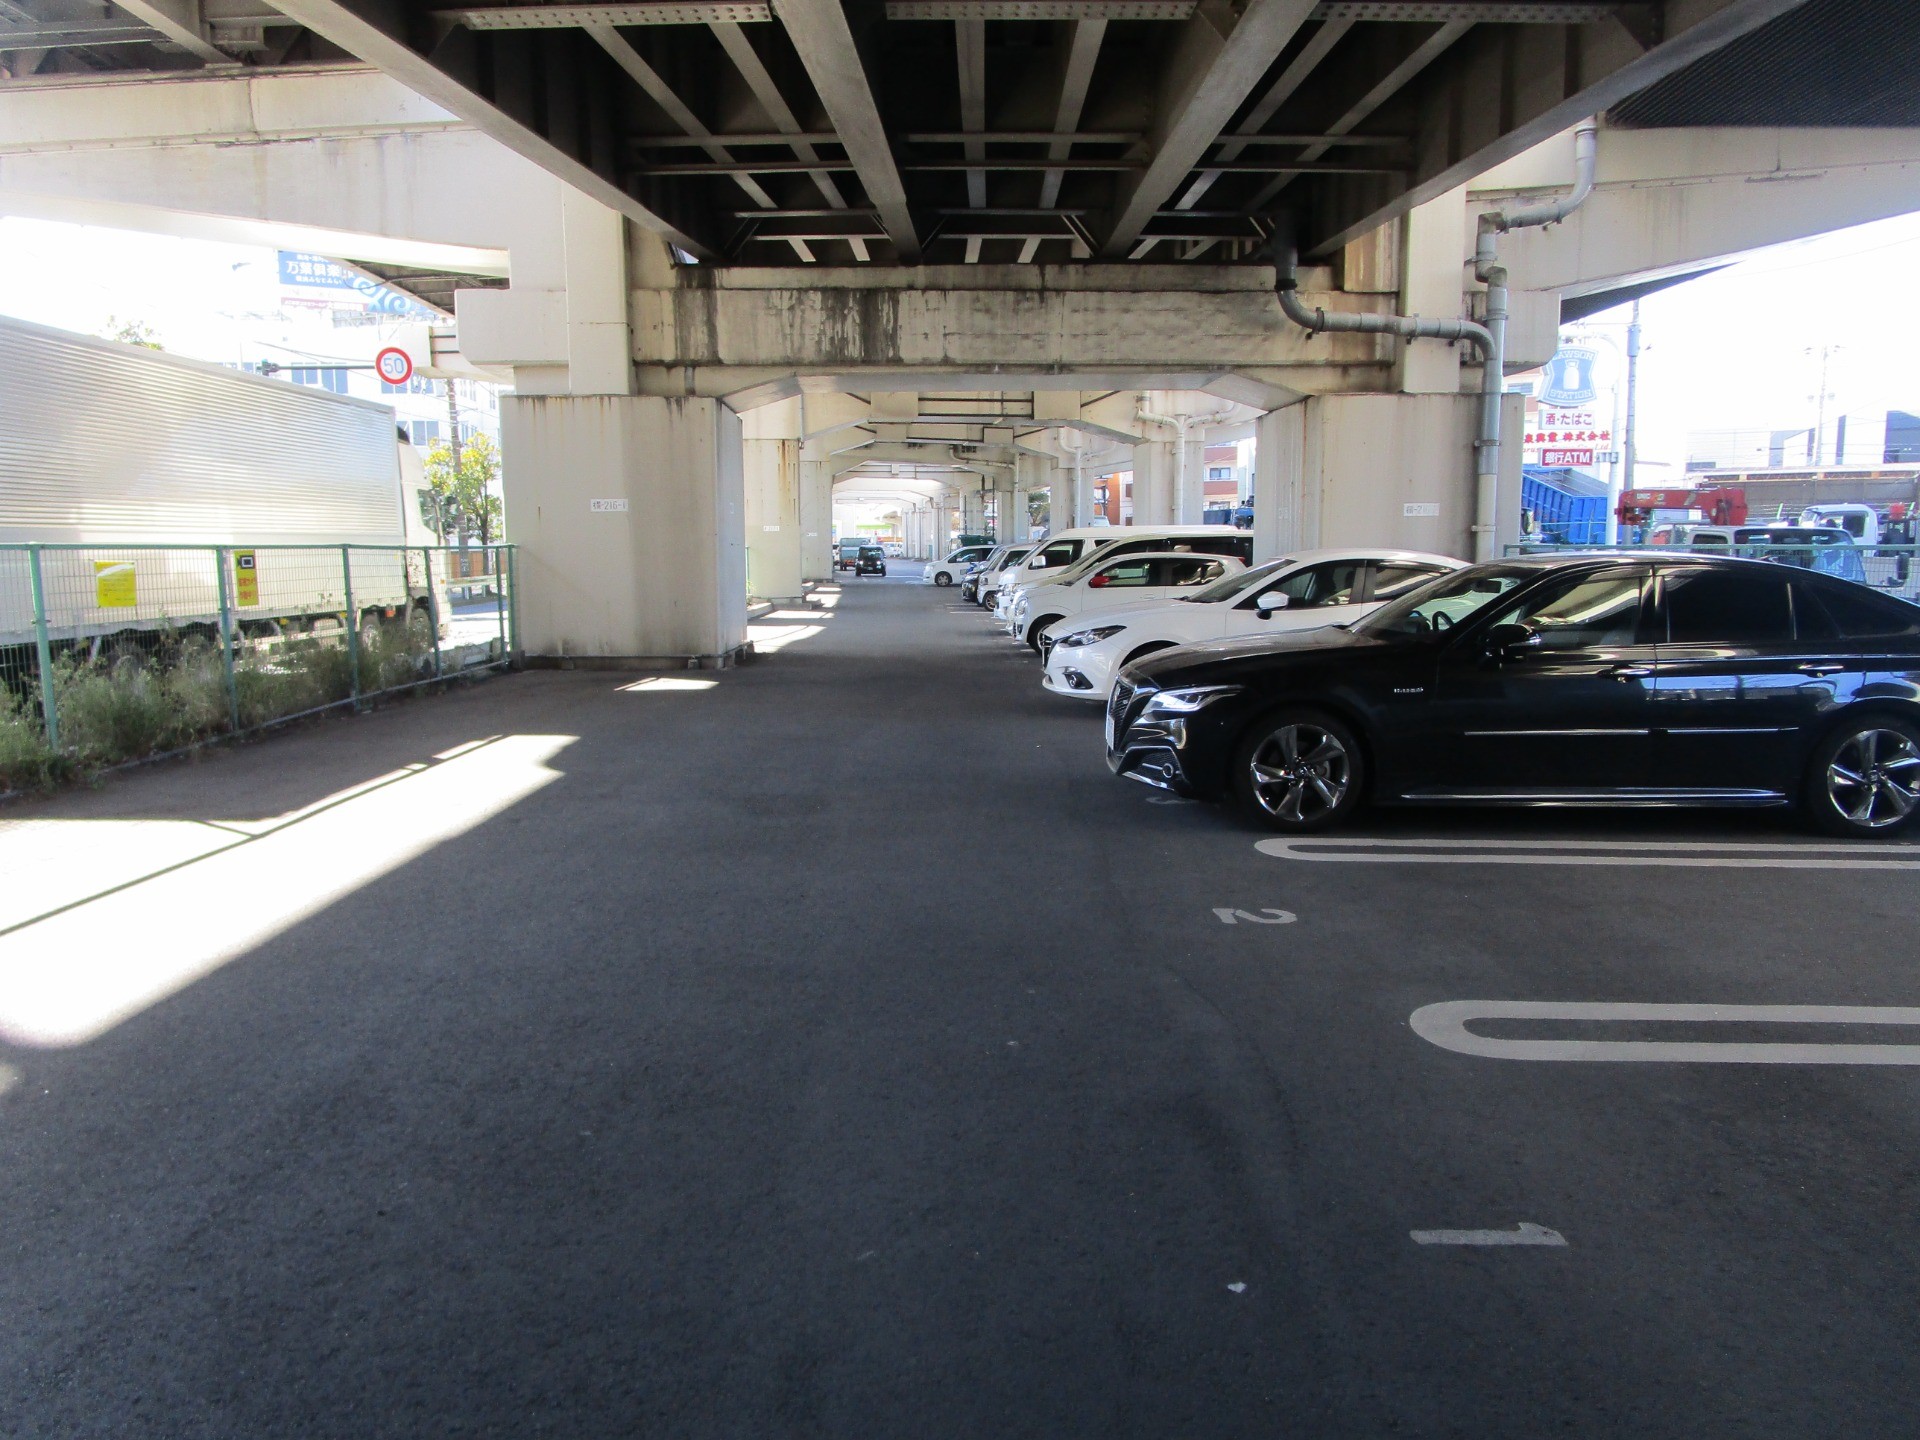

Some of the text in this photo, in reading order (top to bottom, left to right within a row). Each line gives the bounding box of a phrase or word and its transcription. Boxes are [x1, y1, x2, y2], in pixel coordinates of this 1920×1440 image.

[1553, 350, 1595, 361] AWSON
[383, 357, 405, 374] 50
[1549, 389, 1593, 400] STATION
[1544, 451, 1591, 464] 銀行ATM
